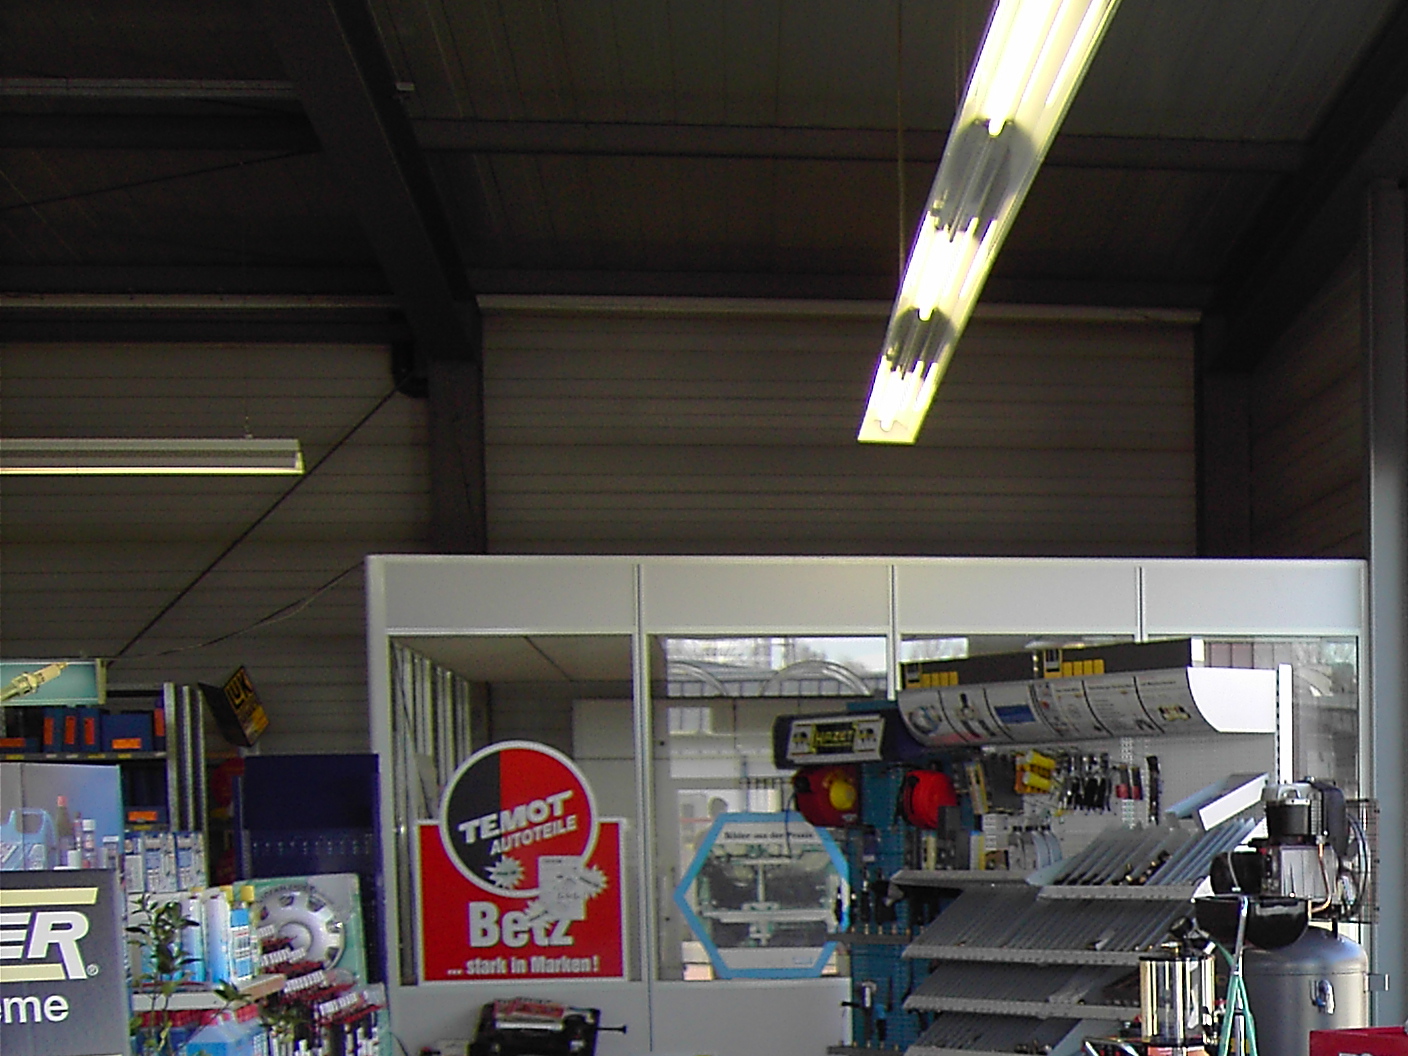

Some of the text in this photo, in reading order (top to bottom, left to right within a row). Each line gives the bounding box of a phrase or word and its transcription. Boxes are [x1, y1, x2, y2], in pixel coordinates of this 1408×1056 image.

[458, 790, 573, 844] TEMOT
[489, 815, 577, 856] AUTOTEILE
[468, 901, 574, 948] Betz
[466, 957, 503, 975] stark
[511, 956, 528, 974] in
[0, 994, 69, 1024] me
